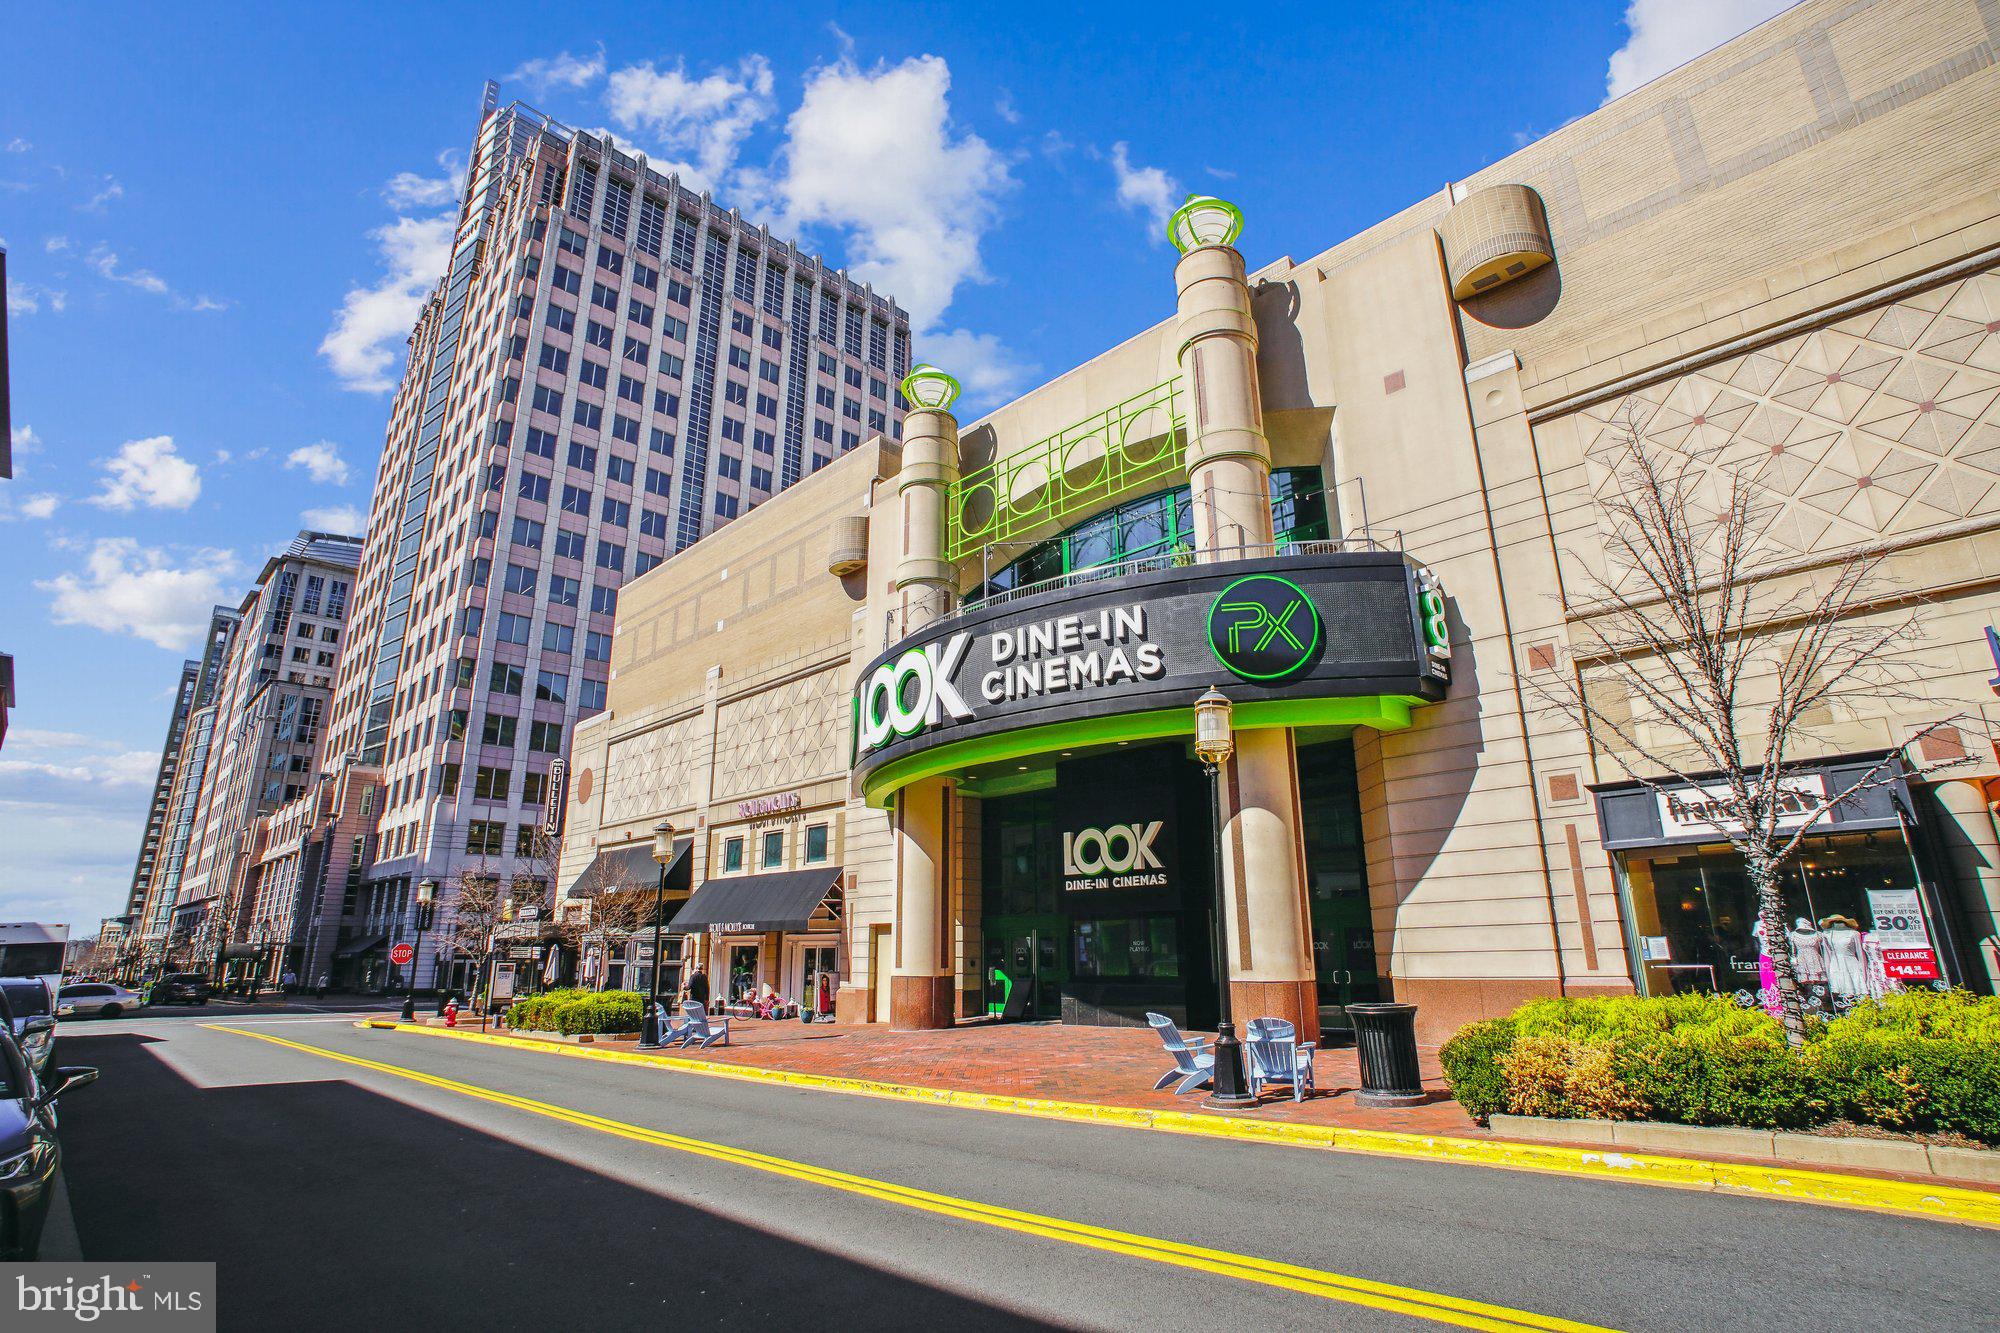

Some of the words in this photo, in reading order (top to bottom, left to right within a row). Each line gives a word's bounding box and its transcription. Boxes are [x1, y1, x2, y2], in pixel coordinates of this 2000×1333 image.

[992, 605, 1147, 666] DINE-IN
[1221, 601, 1304, 653] PX
[859, 632, 976, 752] LOOK
[981, 643, 1163, 700] CINEMAS
[547, 766, 562, 831] BULLETIN
[1063, 821, 1165, 876] LOOK
[1065, 878, 1109, 891] DINE-IN
[1112, 873, 1167, 888] CINEMAS
[393, 949, 413, 958] STOP
[1313, 941, 1329, 950] OOK
[1886, 951, 1929, 960] CLEARANCE
